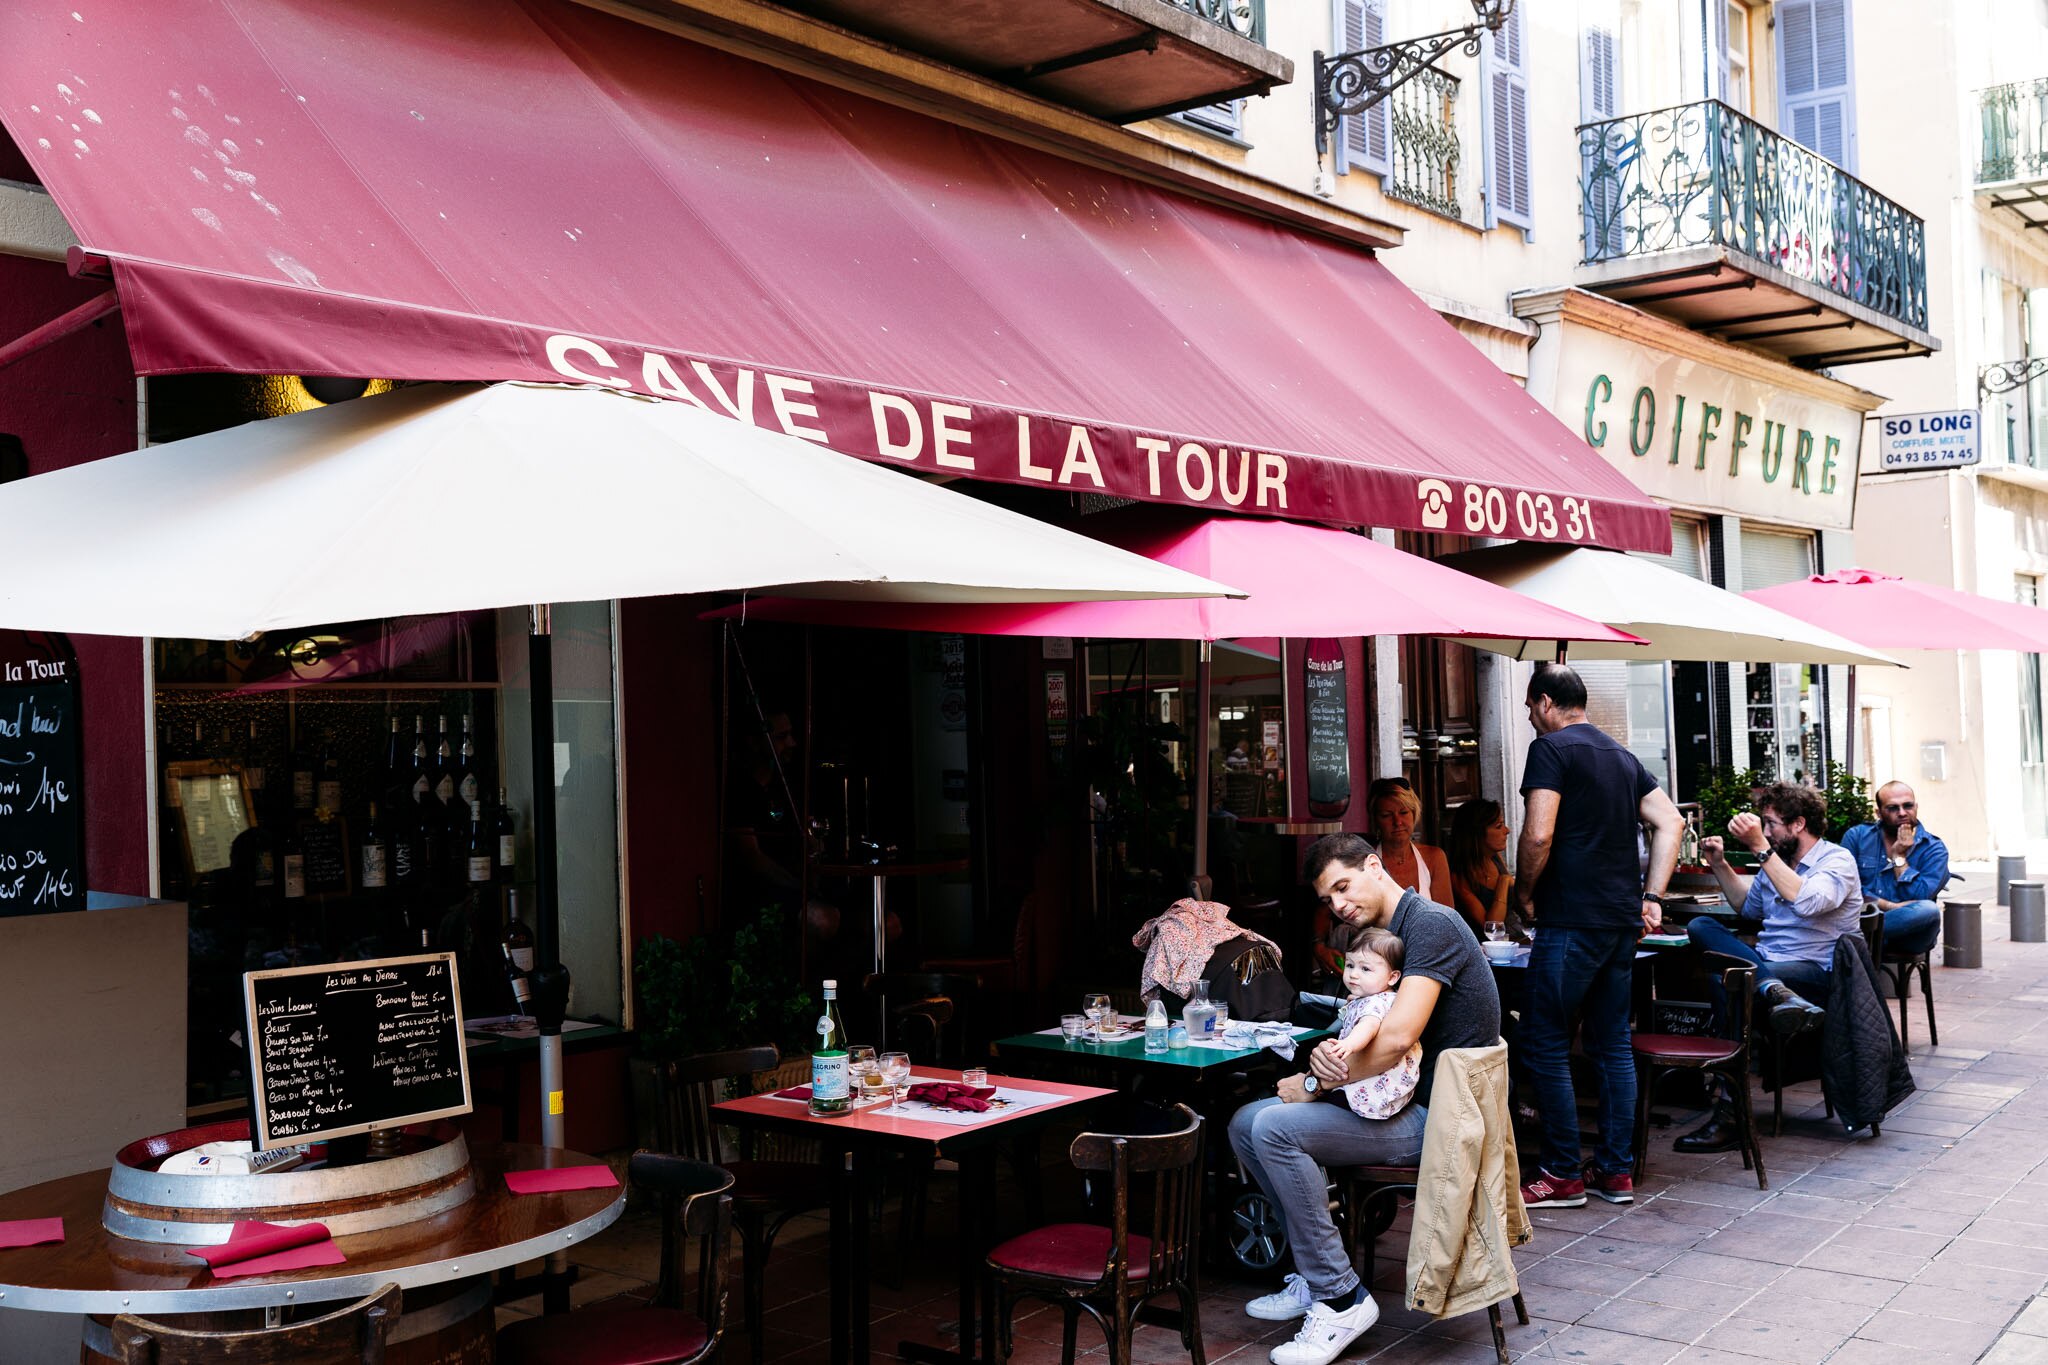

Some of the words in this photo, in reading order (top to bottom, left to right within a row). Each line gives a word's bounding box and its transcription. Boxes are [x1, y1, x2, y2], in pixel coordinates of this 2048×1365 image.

[546, 334, 829, 443] CAVE
[868, 391, 975, 470] DE
[1018, 415, 1105, 488] LA
[1136, 437, 1288, 508] TOUR
[1886, 420, 1911, 435] SO
[1920, 416, 1972, 432] LONG
[1585, 374, 1840, 494] COIFFURE
[1892, 438, 1934, 448] COIFFURE
[1940, 436, 1965, 444] MIXTE
[1887, 455, 1901, 464] 04
[1906, 453, 1919, 462] 93
[1924, 452, 1936, 461] 85
[1942, 451, 1954, 459] 74
[1959, 449, 1972, 458] 45
[1464, 484, 1507, 534] 80
[1516, 491, 1558, 538] 03
[1563, 497, 1595, 540] 31
[6, 663, 22, 681] la
[27, 660, 66, 680] Tour
[1320, 660, 1326, 672] de
[1327, 660, 1333, 670] la
[1049, 681, 1063, 690] 2007
